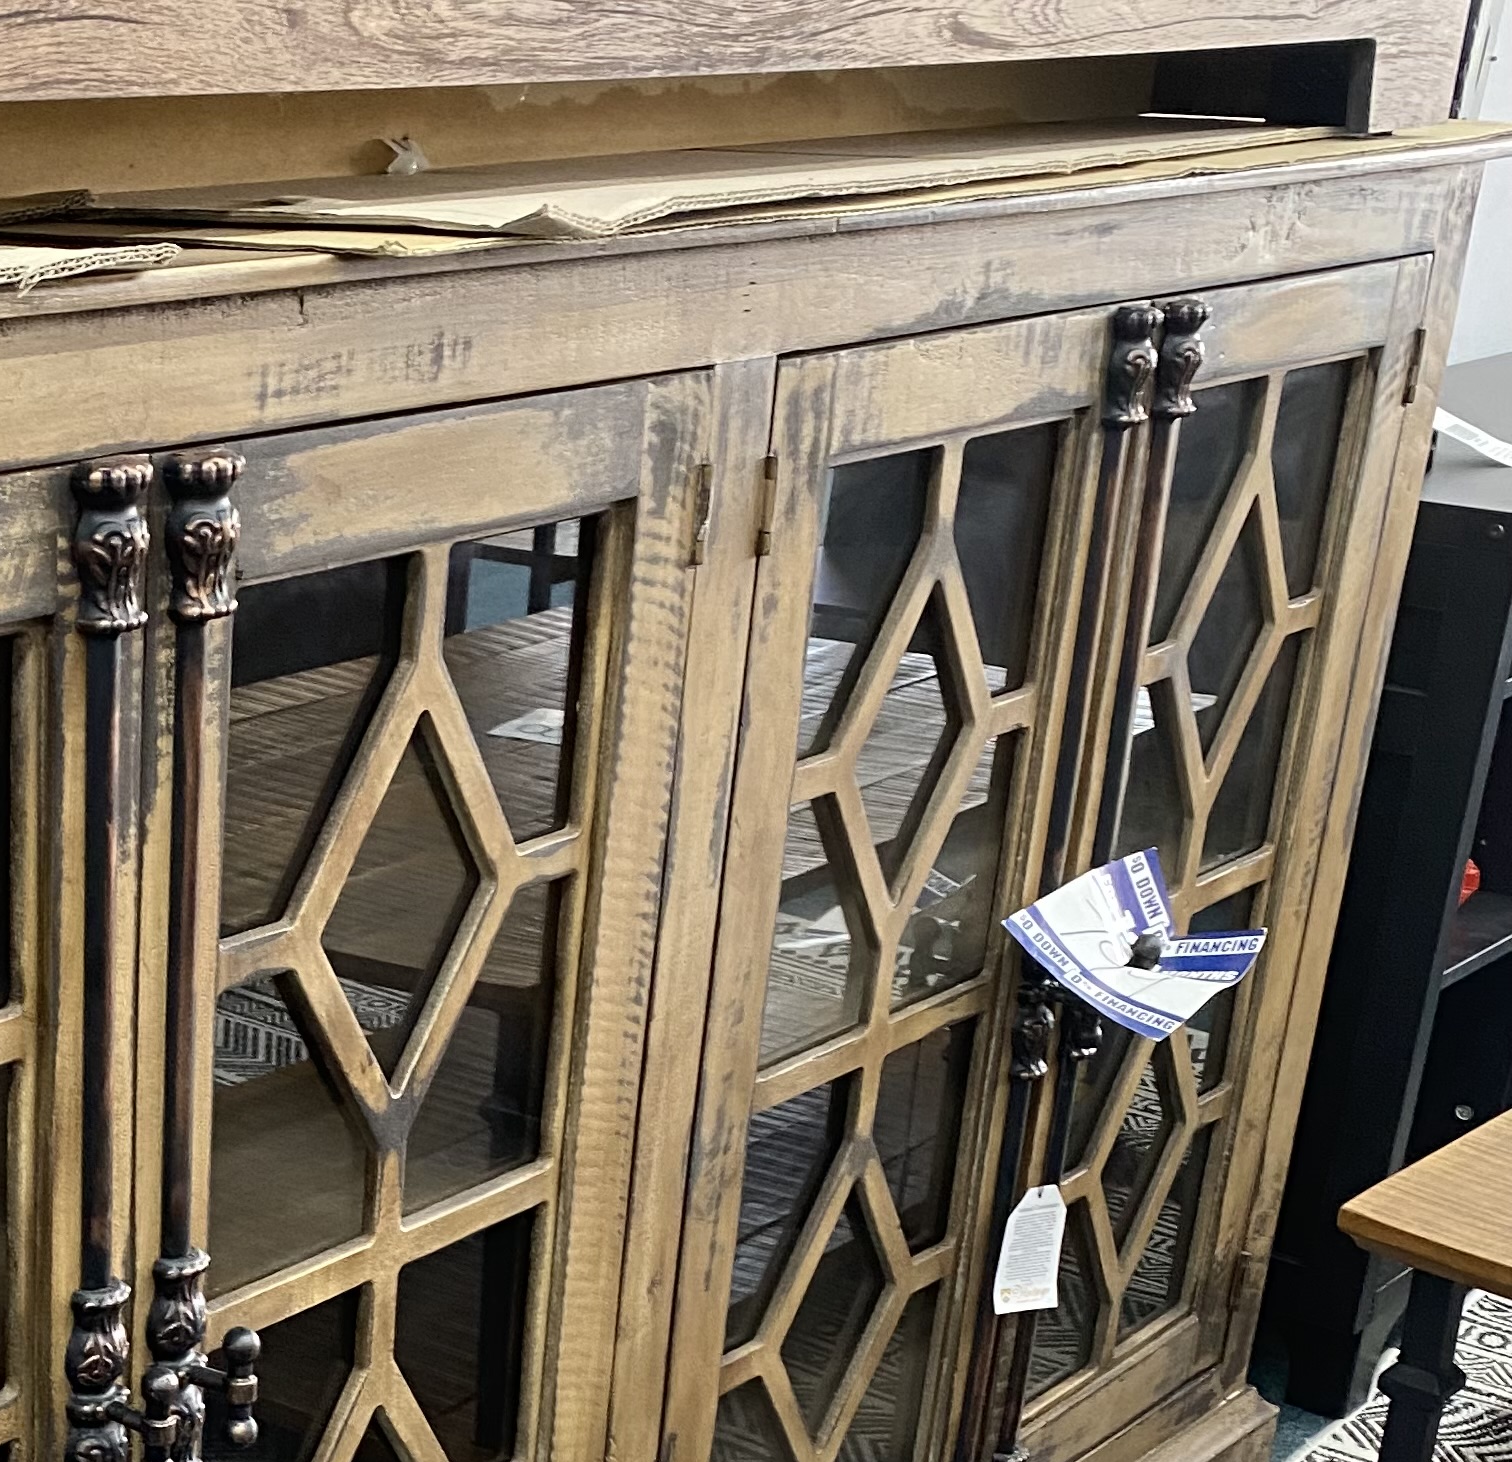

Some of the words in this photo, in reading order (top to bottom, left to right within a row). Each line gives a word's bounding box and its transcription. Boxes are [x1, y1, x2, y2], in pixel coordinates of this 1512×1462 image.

[1136, 877, 1164, 919] DOWN
[1174, 937, 1259, 955] FINANCING
[1033, 932, 1070, 967] DOWN
[1070, 974, 1092, 990] 0%
[1094, 991, 1176, 1030] FINANCING
